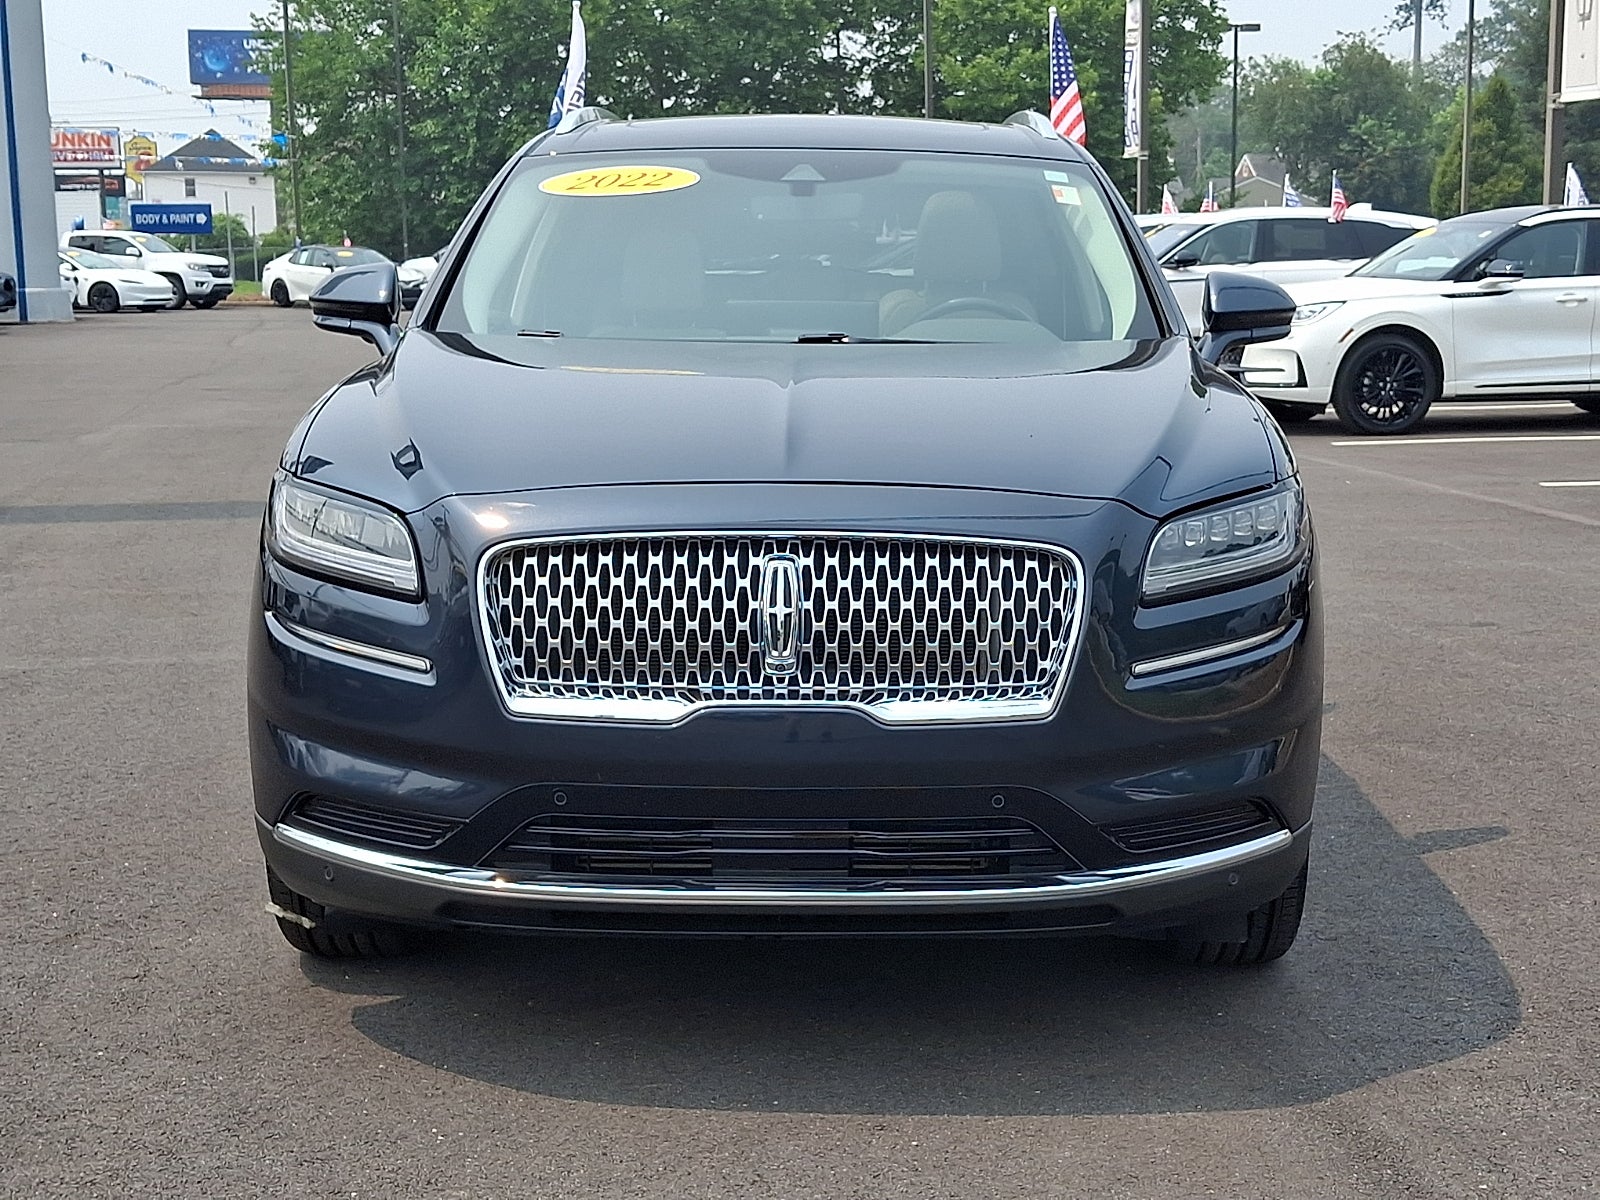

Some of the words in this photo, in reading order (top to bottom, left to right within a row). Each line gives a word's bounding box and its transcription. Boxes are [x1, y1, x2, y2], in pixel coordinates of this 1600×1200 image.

[566, 172, 673, 191] 2022
[135, 213, 160, 225] BODY
[162, 213, 169, 224] &
[170, 212, 195, 224] PAINT
